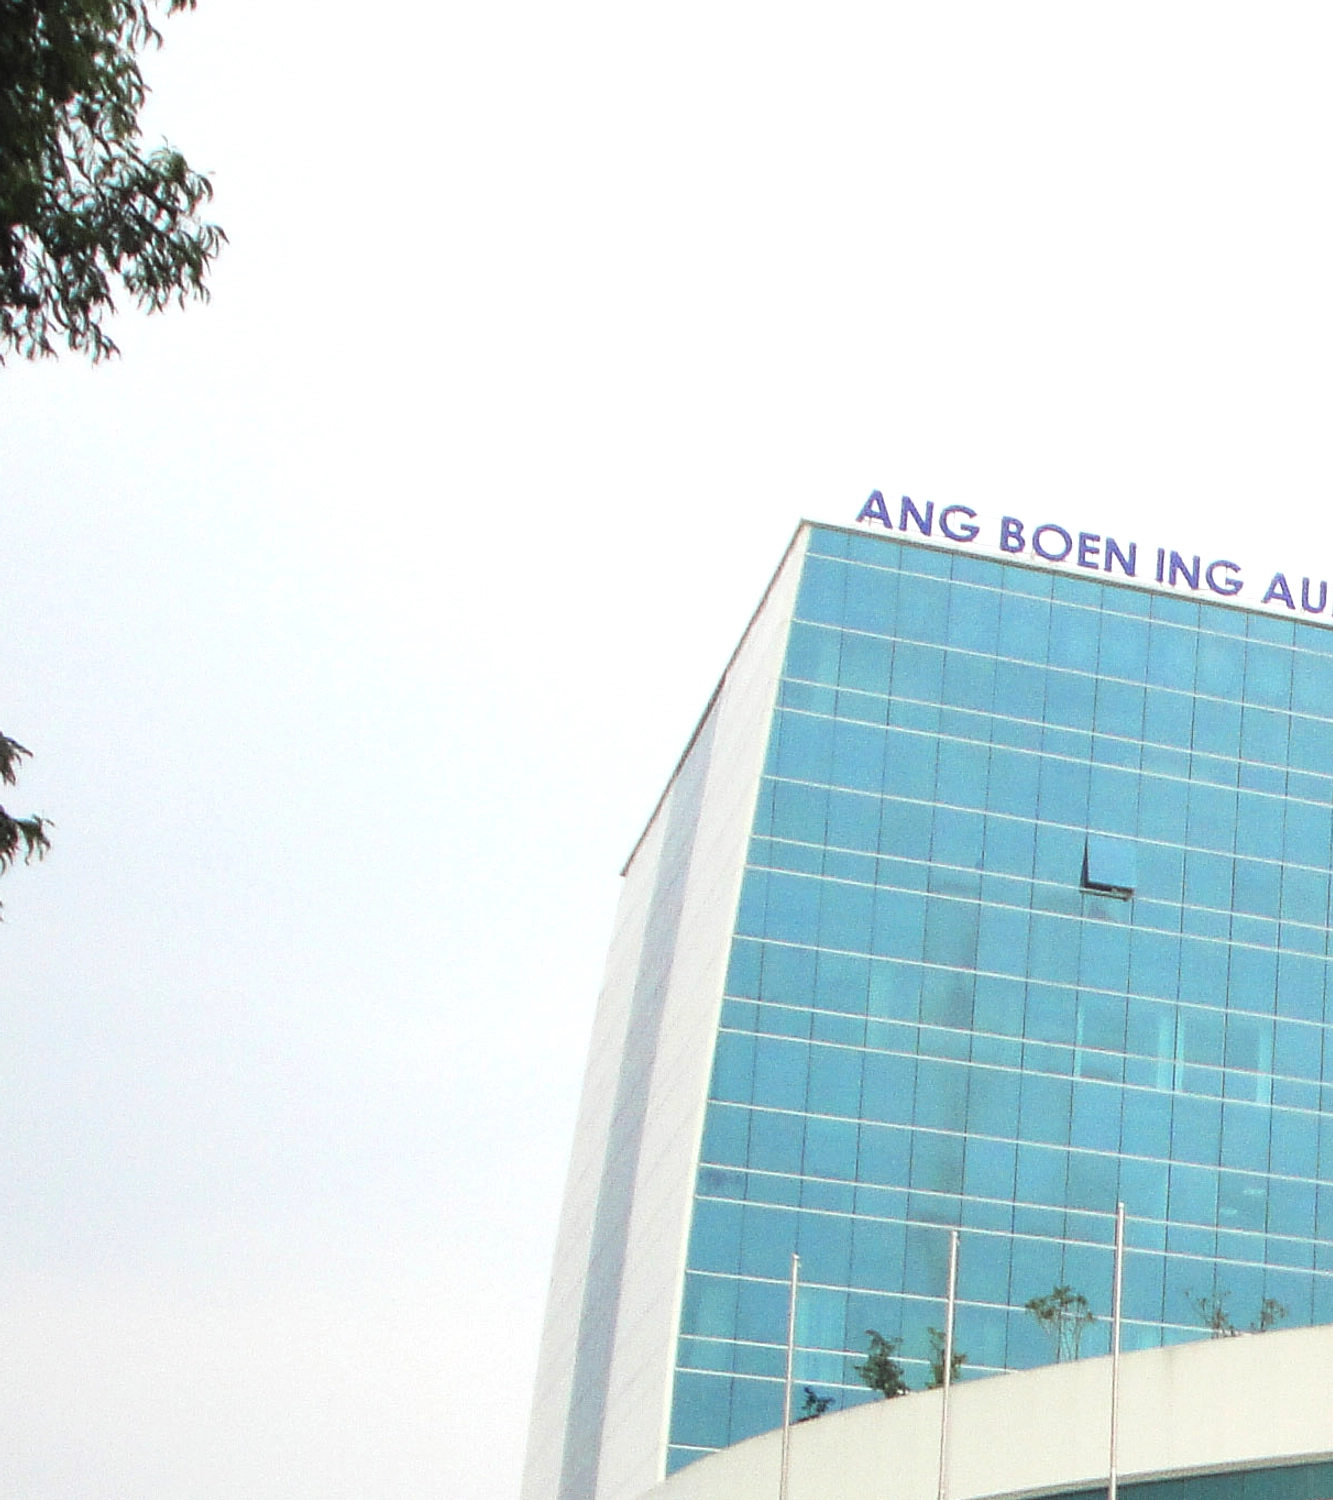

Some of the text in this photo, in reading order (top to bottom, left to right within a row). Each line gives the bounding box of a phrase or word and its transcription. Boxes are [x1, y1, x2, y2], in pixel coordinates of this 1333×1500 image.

[855, 490, 981, 543] ANG
[999, 515, 1137, 577] BOEN
[1154, 547, 1245, 597] ING
